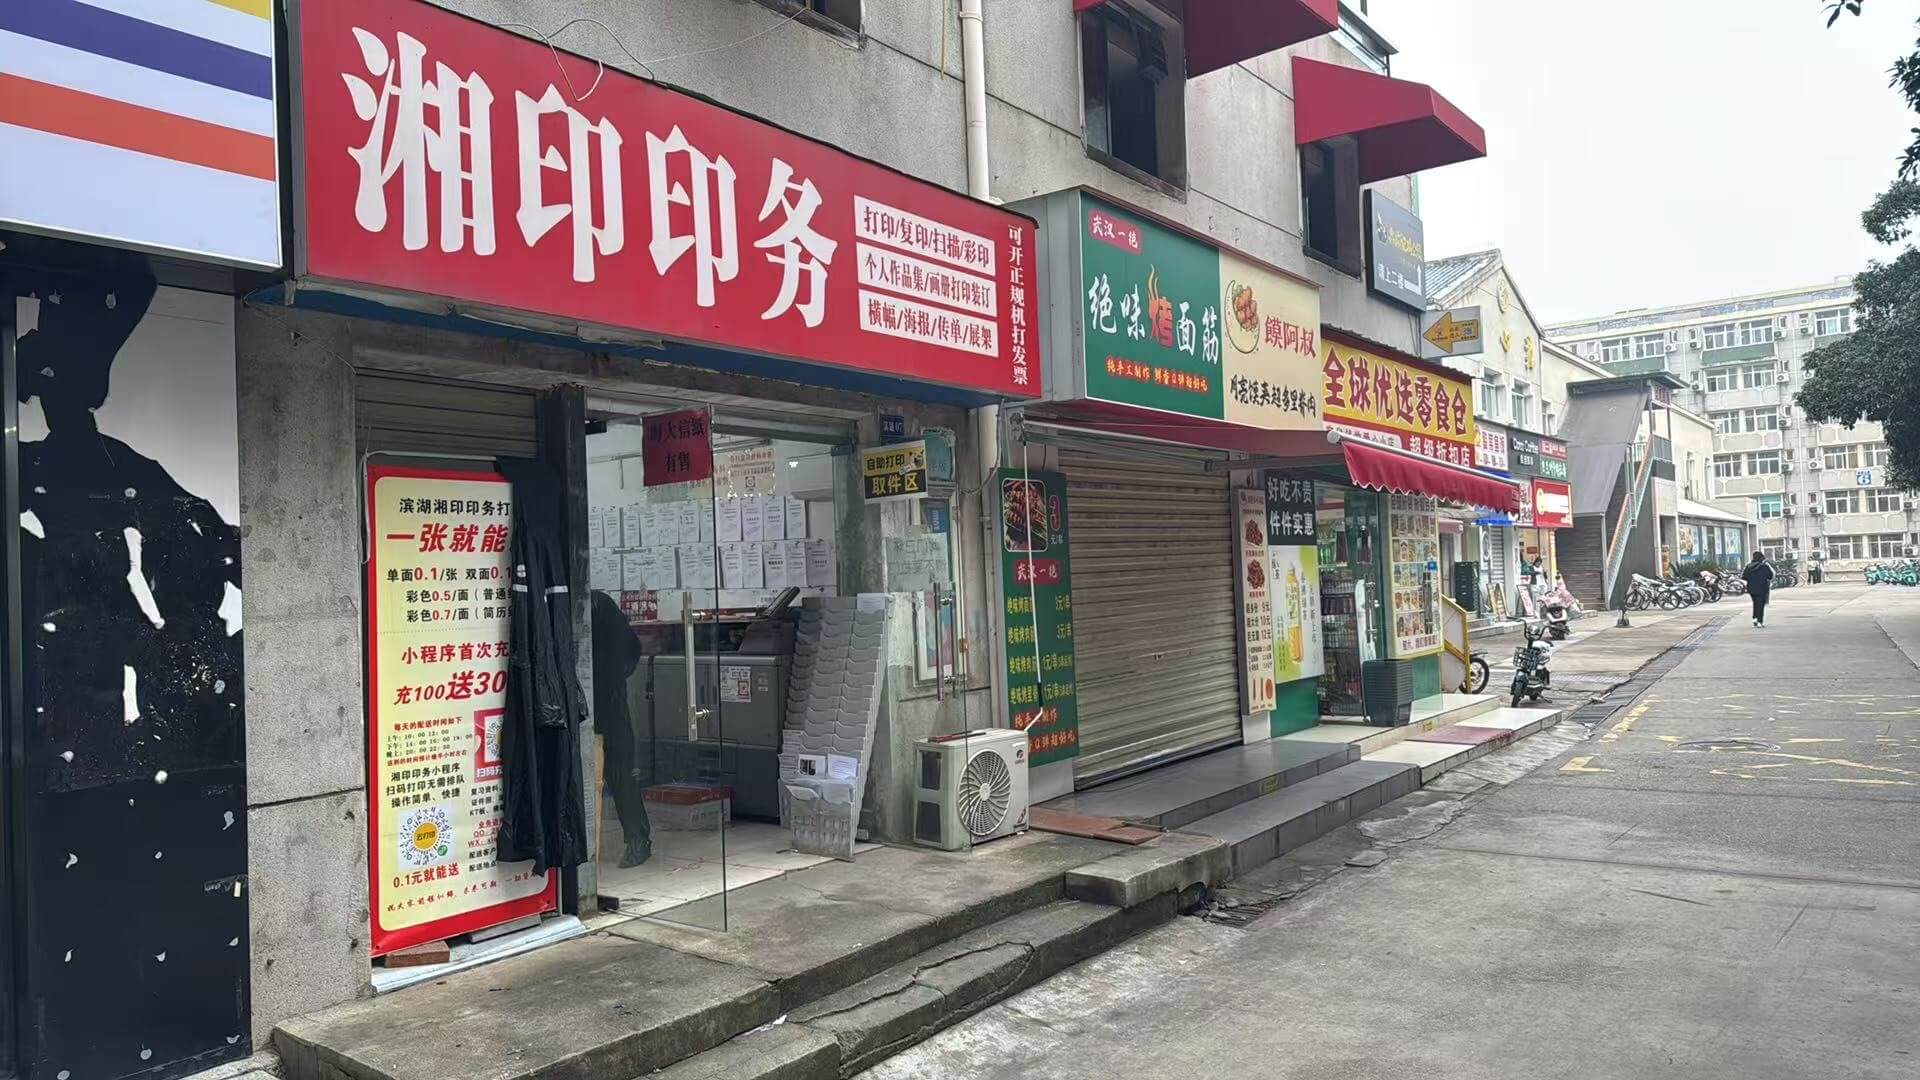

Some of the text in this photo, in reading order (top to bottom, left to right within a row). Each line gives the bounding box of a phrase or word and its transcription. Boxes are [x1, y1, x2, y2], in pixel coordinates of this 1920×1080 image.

[342, 25, 838, 329] 湘印印务
[863, 205, 990, 268] 打印/复印/扫描/彩印
[864, 252, 991, 309] 个人作品集/画册打印装订
[1007, 224, 1028, 385] 可开正规机打发票
[867, 297, 992, 350] 横幅/海报/传单/展架
[866, 454, 905, 471] 自助打印
[871, 472, 920, 496] 取件区
[399, 498, 511, 516] 滨湖湘印印务打
[1270, 510, 1315, 536] 件件实惠
[386, 523, 512, 553] 一张就能
[387, 567, 458, 582] 单面0.1/张
[401, 641, 509, 664] 小程序首次充
[390, 762, 461, 782] 湘印印务小程序
[386, 775, 465, 796] 扫码打印无需排队
[393, 862, 459, 888] 0.1元就能送
